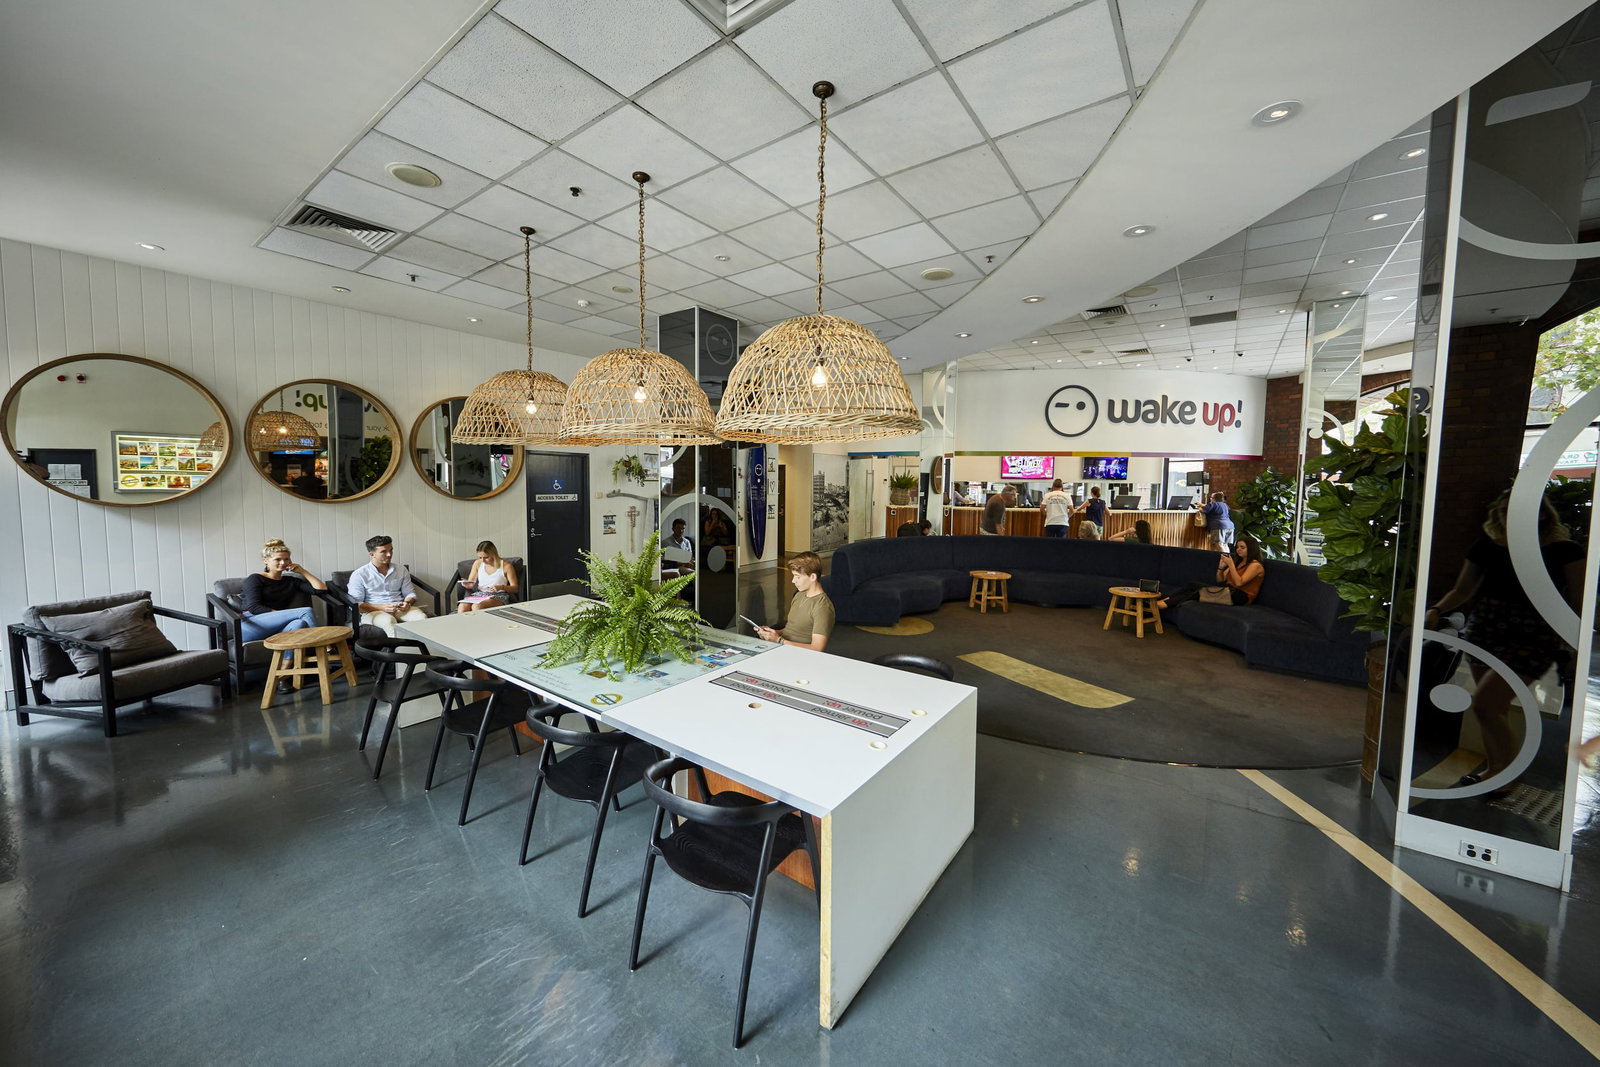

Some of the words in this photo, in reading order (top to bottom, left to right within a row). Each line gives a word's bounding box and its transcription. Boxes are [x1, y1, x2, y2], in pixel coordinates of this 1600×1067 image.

[1107, 394, 1197, 425] wake
[1202, 399, 1243, 433] up!
[730, 681, 761, 693] power
[760, 682, 793, 693] power
[822, 700, 842, 708] up!
[811, 707, 851, 720] power
[851, 718, 873, 728] up!
[842, 706, 884, 720] power
